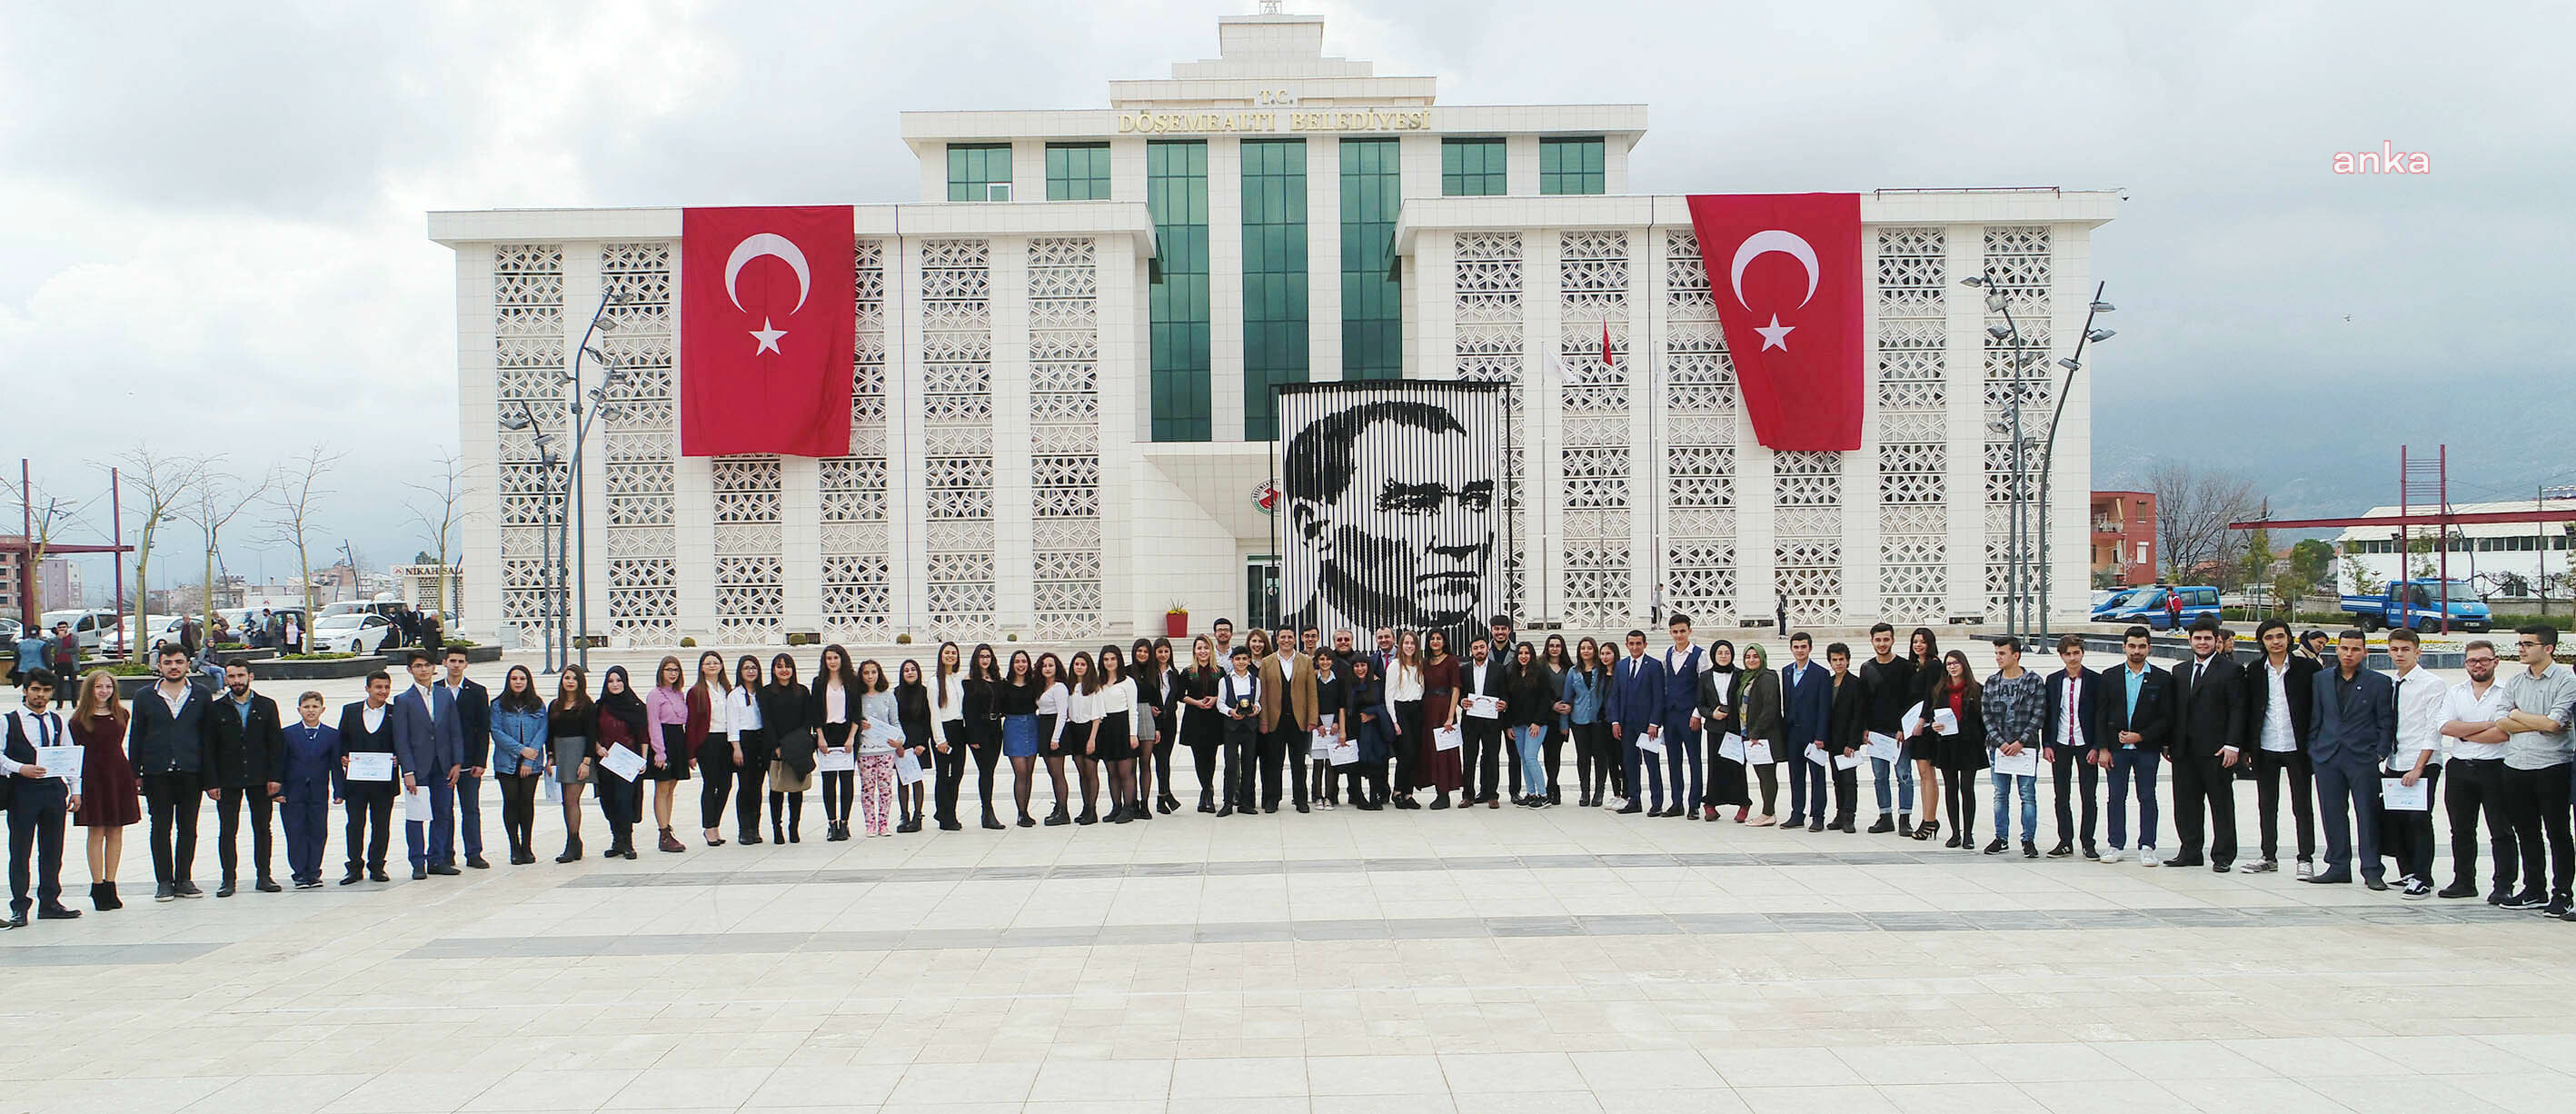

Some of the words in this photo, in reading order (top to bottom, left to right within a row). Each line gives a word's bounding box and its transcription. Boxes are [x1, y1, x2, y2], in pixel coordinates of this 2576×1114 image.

[1259, 91, 1294, 104] T.C.
[1119, 109, 1275, 134] DÖŞEMEALTI
[1290, 107, 1430, 131] BELEDİYESİ
[405, 565, 439, 575] NİKAH
